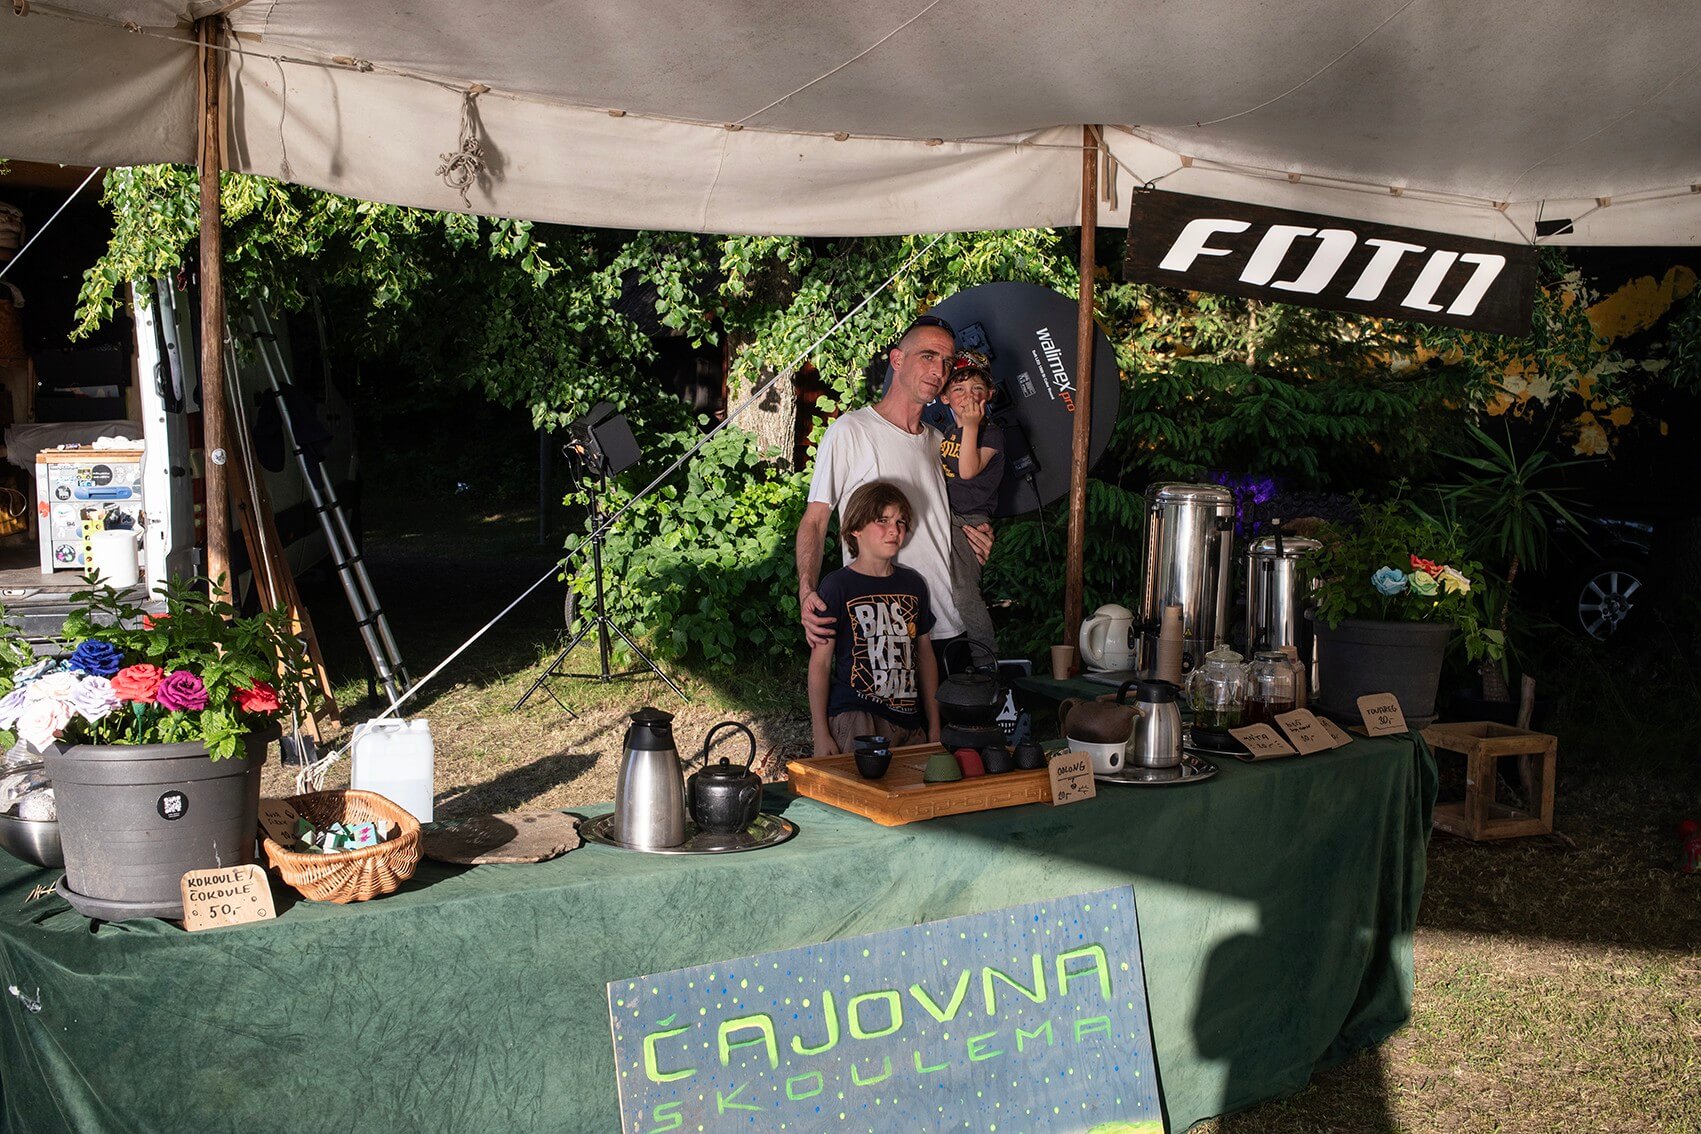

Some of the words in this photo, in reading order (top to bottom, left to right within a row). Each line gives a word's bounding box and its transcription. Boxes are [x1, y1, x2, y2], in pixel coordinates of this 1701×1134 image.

[1158, 218, 1506, 317] FOTO
[1036, 327, 1077, 392] walimex
[1058, 391, 1076, 412] pro
[854, 602, 909, 638] BAS
[867, 635, 912, 670] KET
[872, 669, 918, 699] BALL
[643, 944, 1113, 1083] ČAJOVNA
